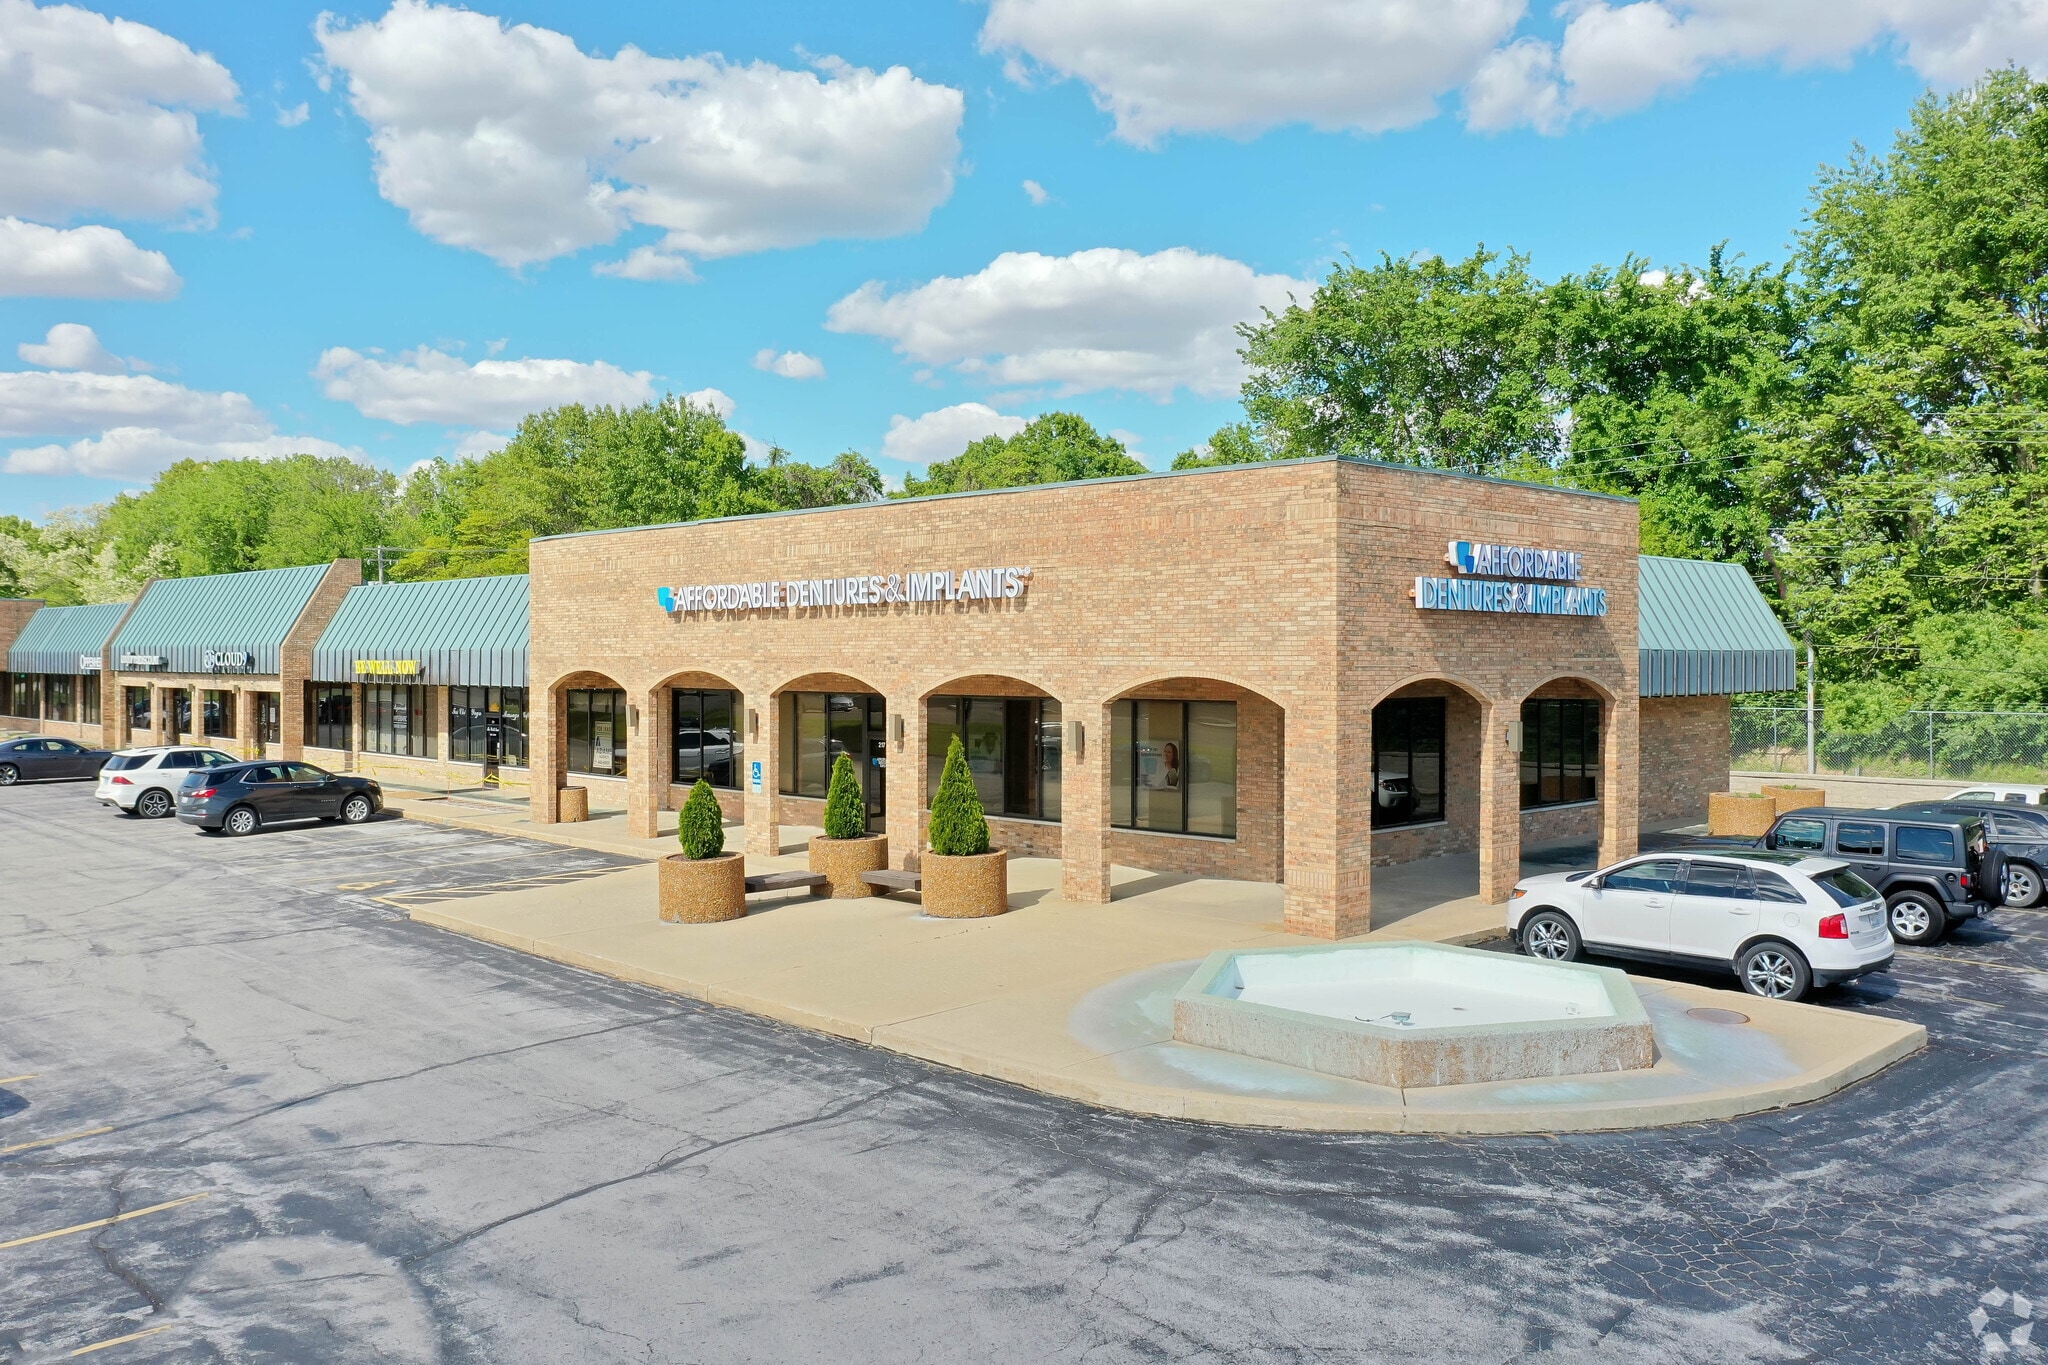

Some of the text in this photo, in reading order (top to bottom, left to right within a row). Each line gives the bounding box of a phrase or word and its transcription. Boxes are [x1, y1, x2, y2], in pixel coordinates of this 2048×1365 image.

[1475, 543, 1583, 582] AFFORDABLE
[674, 581, 781, 612] AFFORDABLE
[785, 575, 885, 608] DENTURES
[885, 573, 904, 603] &
[1421, 577, 1608, 617] DENTURES & IMPLANTS
[355, 660, 417, 675] BE WELL NOW
